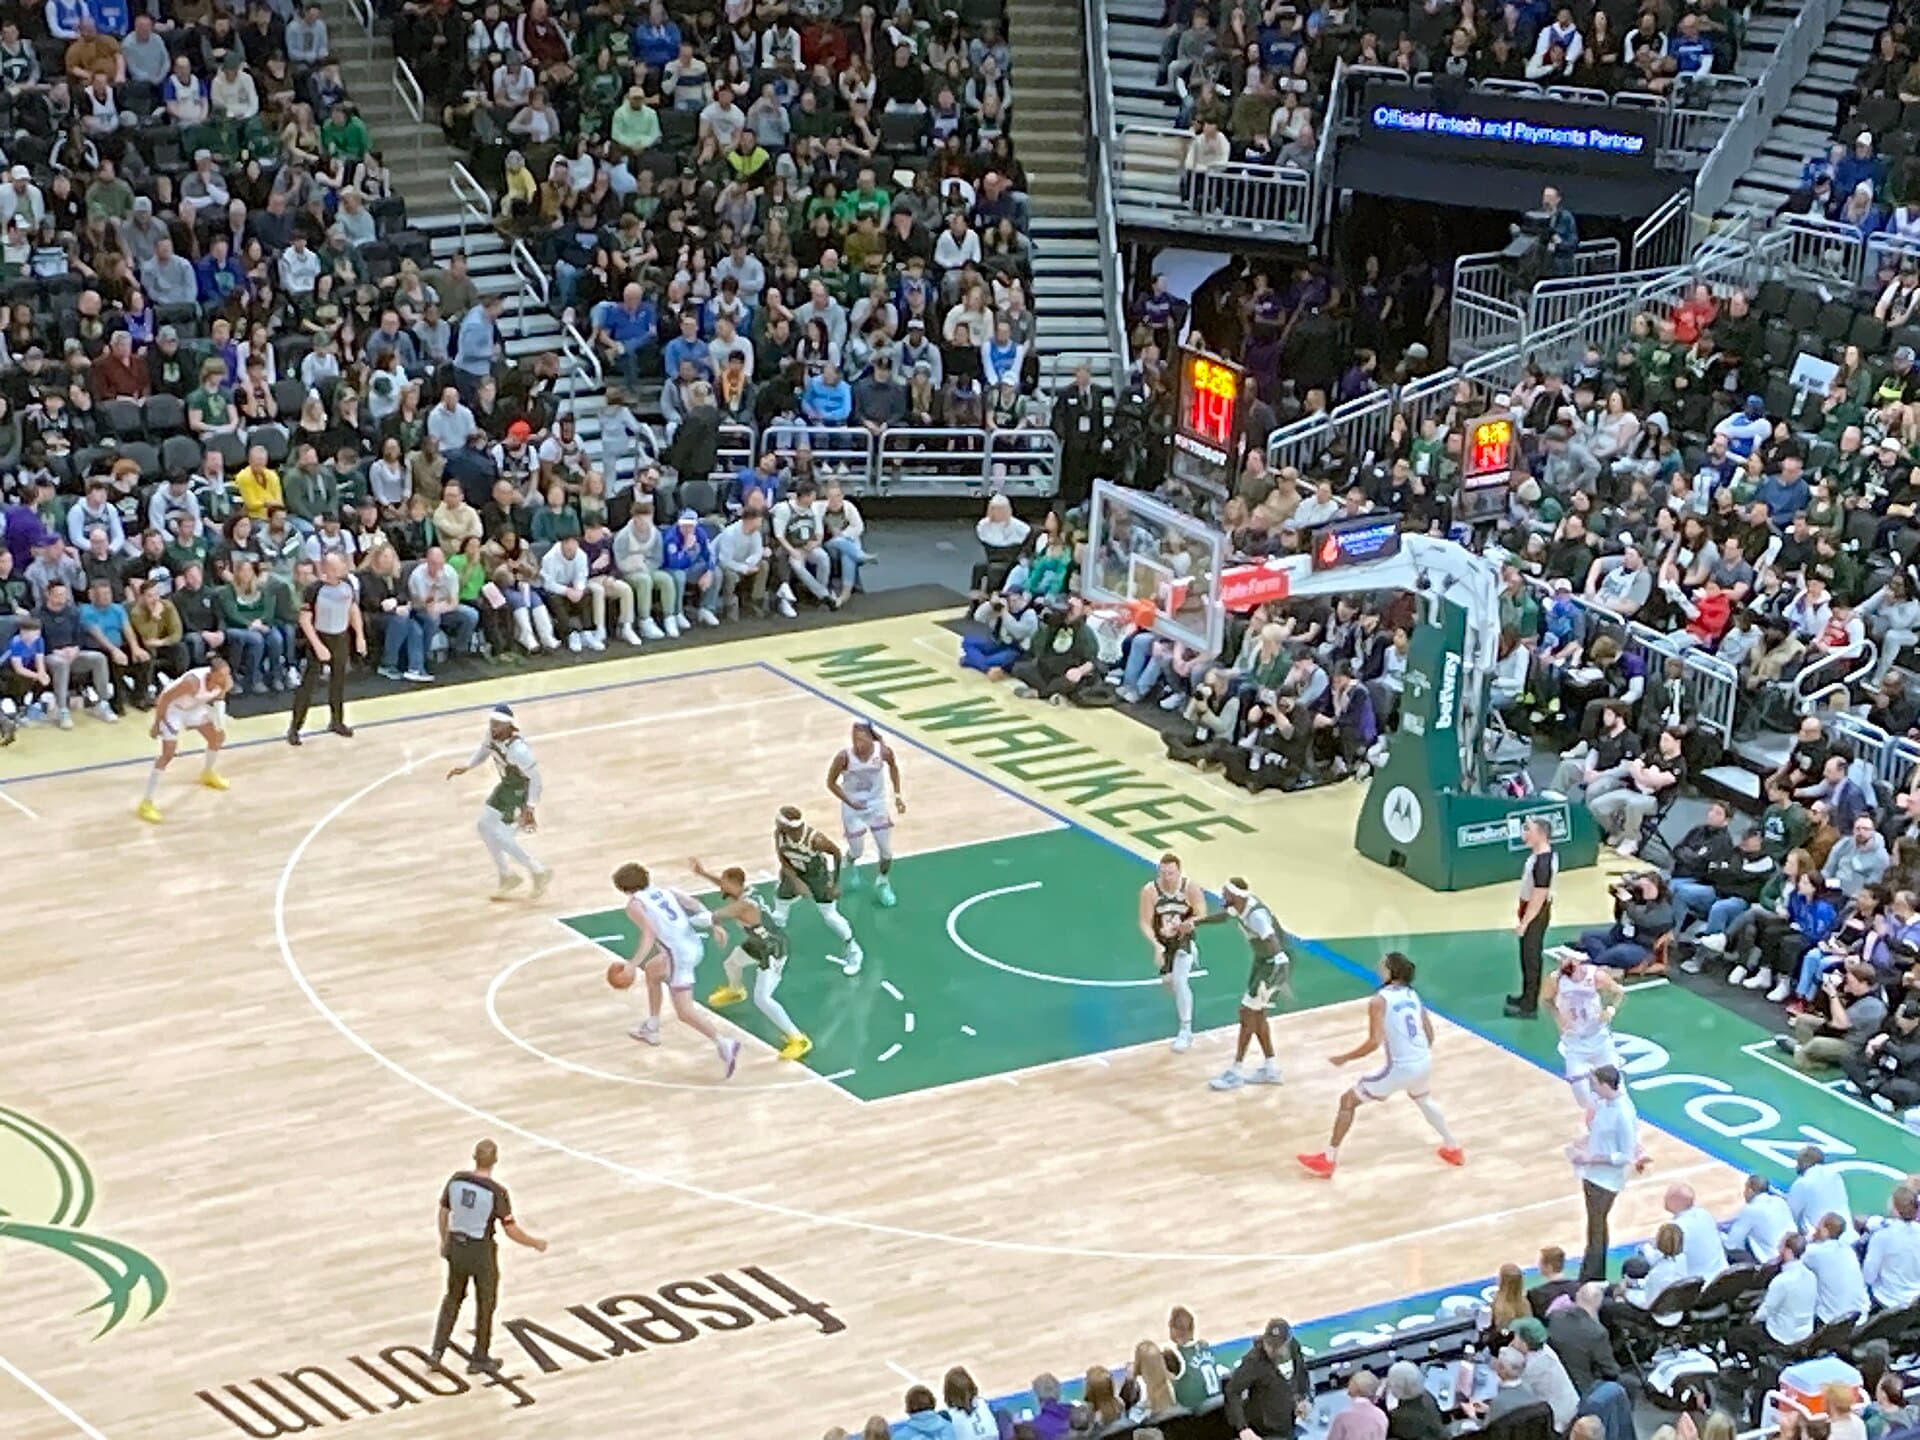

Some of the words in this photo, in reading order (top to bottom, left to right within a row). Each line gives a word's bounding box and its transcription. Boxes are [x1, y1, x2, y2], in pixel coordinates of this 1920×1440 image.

[1373, 106, 1426, 129] Official
[1427, 112, 1482, 134] Fintech
[1483, 120, 1512, 137] and
[1514, 122, 1586, 146] Payments
[1589, 130, 1643, 151] Partner
[1436, 651, 1461, 729] betway
[786, 643, 1259, 850] MILWAUKEE
[502, 1265, 847, 1374] fiserv
[193, 1328, 536, 1439] forum
